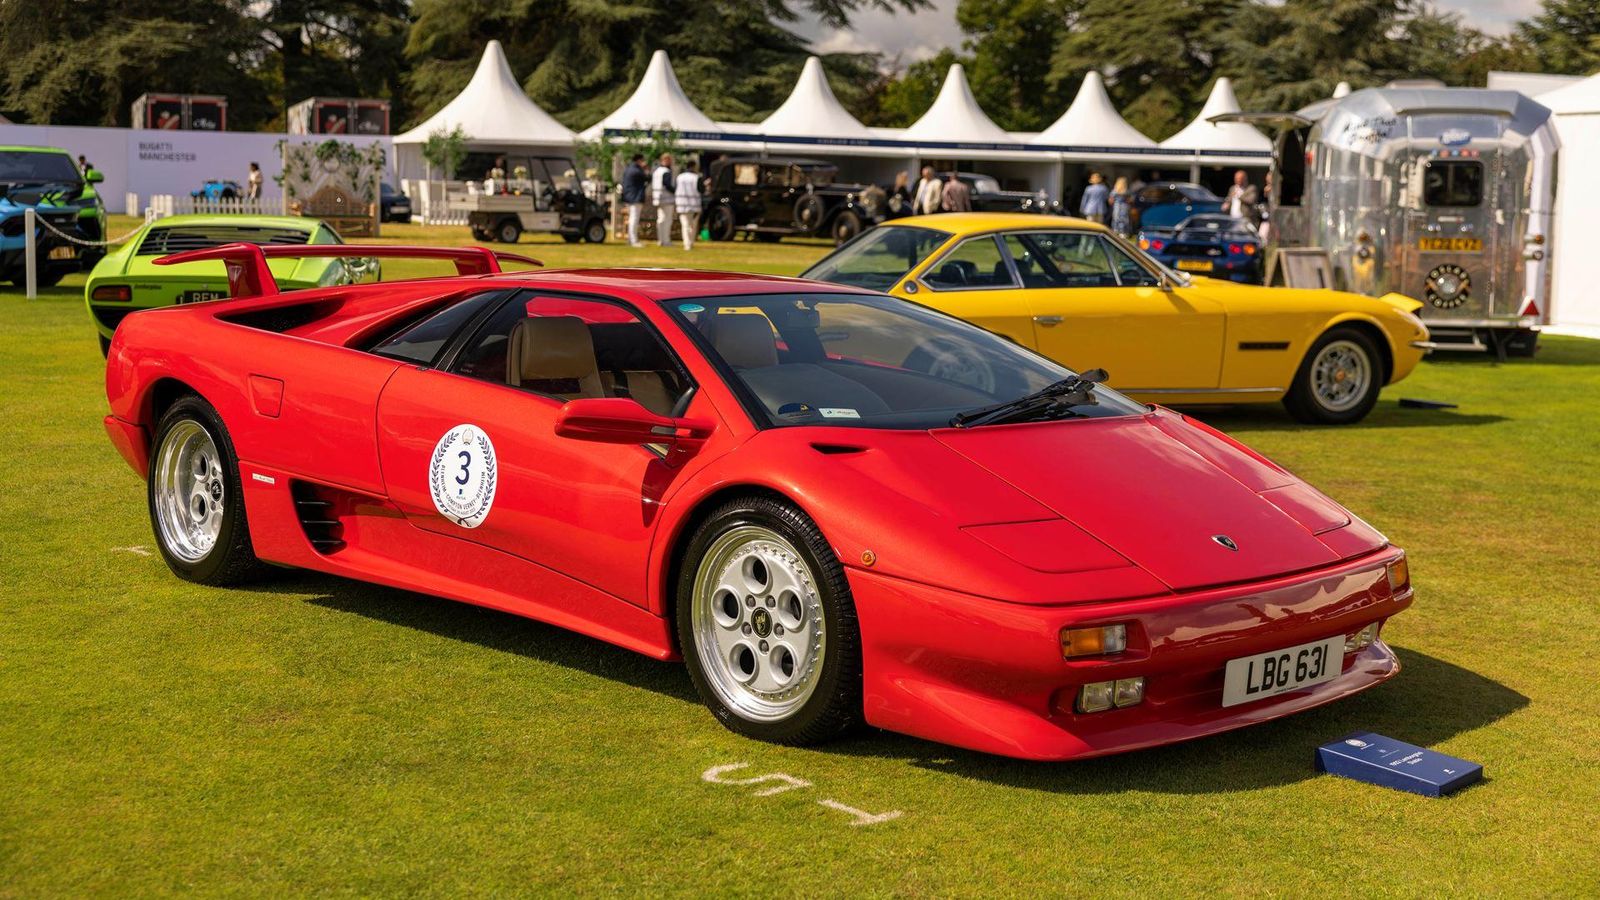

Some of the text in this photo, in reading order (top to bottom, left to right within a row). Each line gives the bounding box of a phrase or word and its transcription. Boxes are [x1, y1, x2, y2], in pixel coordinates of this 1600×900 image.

[139, 142, 173, 151] BUGATTI
[139, 152, 197, 162] MANCHESTER
[455, 450, 472, 486] 3
[1246, 644, 1329, 695] LBG 631
